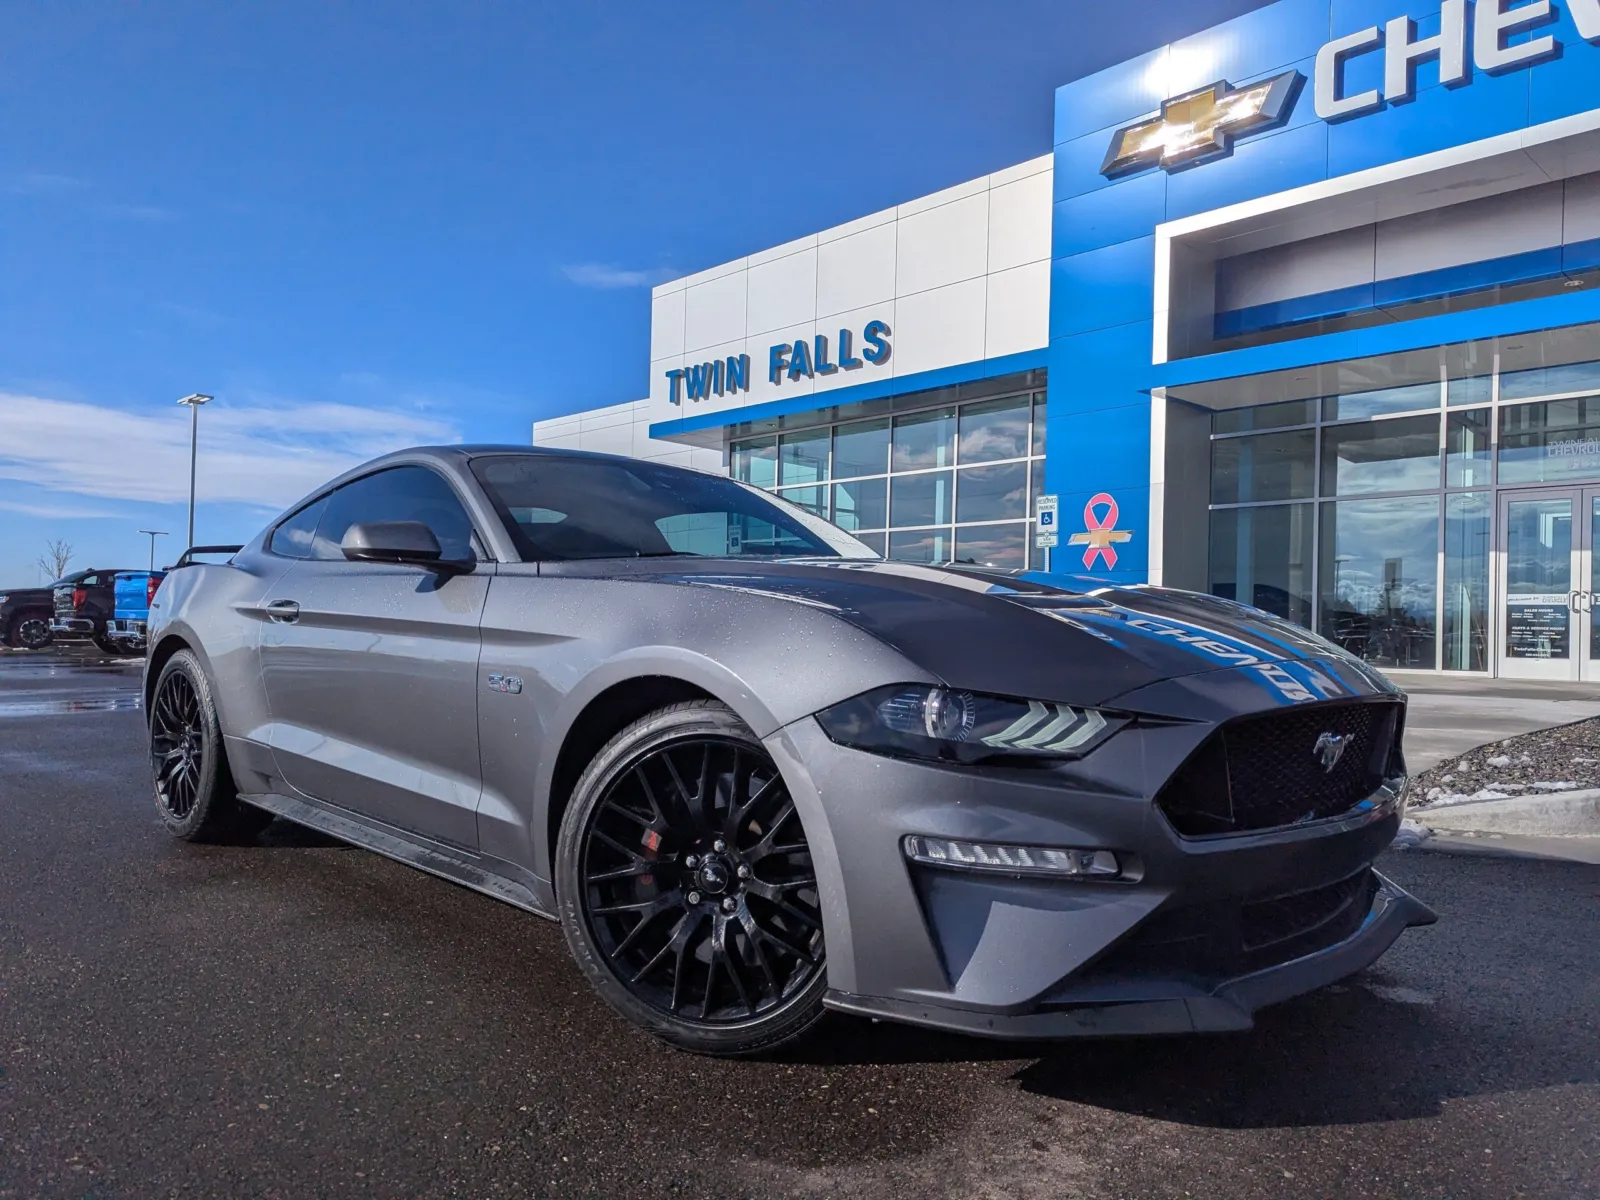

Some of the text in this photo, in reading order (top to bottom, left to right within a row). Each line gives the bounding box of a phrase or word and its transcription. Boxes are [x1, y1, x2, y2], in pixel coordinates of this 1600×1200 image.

[665, 319, 892, 406] TWIN FALLS
[489, 673, 523, 694] 5.0
